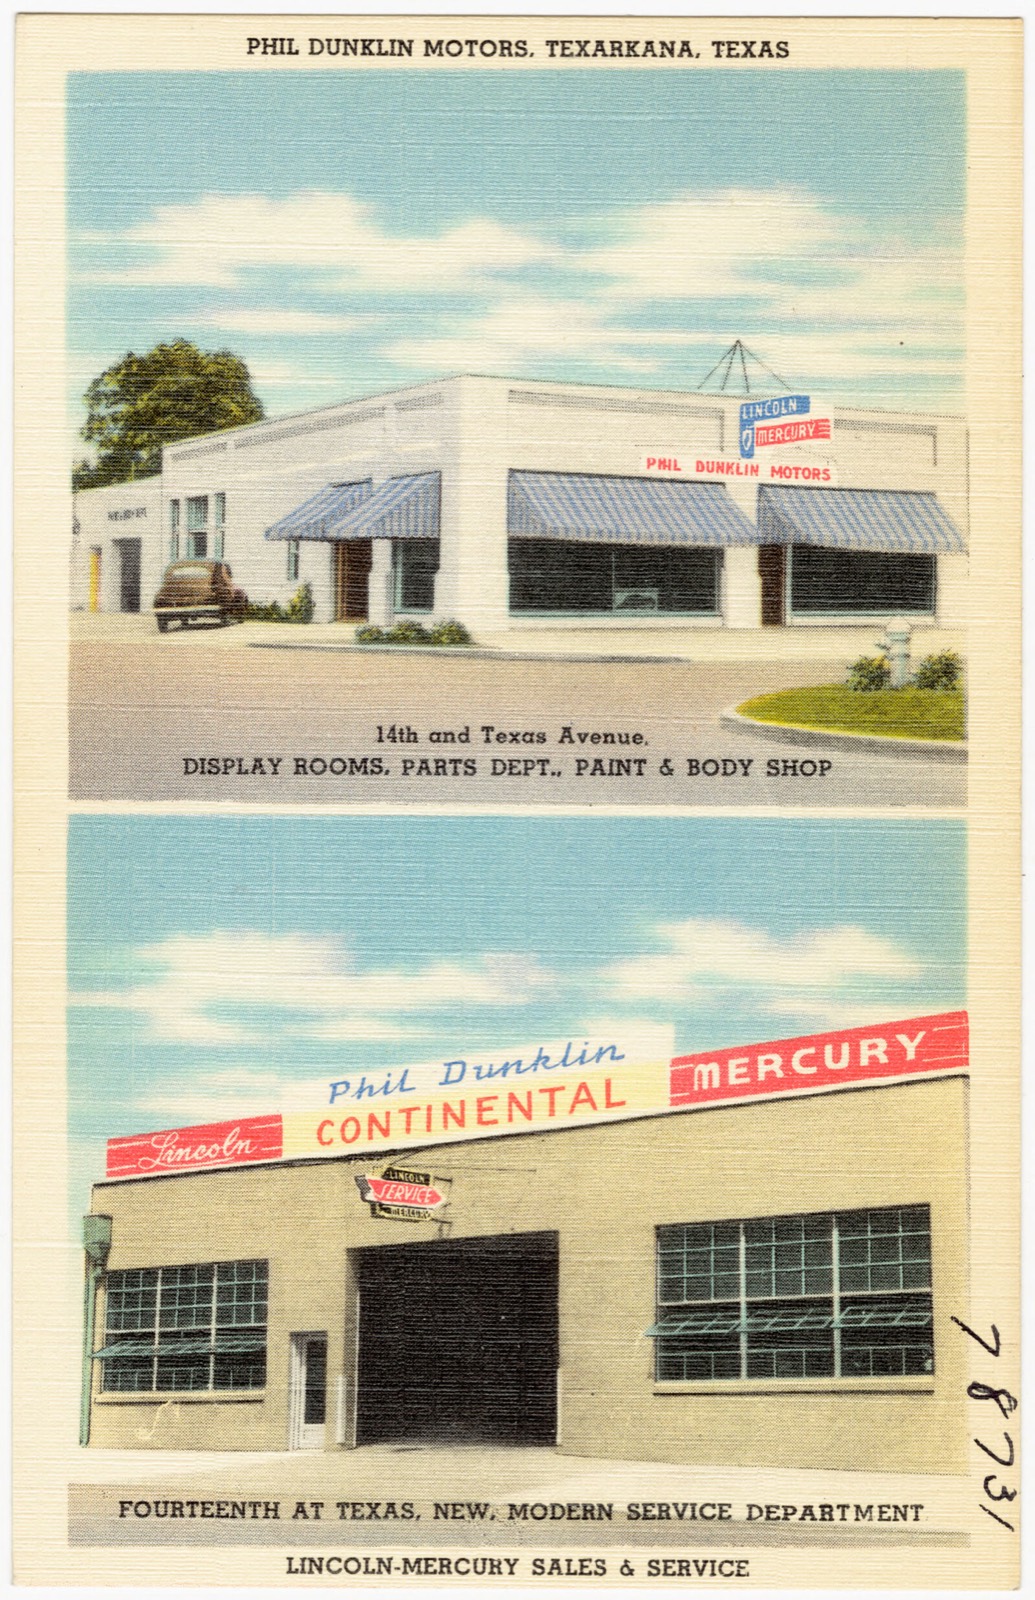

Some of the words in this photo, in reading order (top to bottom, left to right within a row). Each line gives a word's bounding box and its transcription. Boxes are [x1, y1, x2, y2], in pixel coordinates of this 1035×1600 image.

[742, 398, 797, 420] LINCOLN
[757, 423, 816, 445] MERCURY
[646, 457, 681, 472] PHIL
[695, 460, 760, 477] DUNKLIN
[770, 465, 831, 481] MOTORS
[329, 1068, 416, 1104] Phil
[438, 1041, 625, 1086] Dunklin
[693, 1031, 926, 1091] MERCURY
[316, 1078, 626, 1146] CONTINENTAL
[138, 1127, 257, 1170] Lincoln
[376, 1184, 432, 1203] SERVICE
[389, 1170, 426, 1184] LINCOLN
[950, 1315, 1018, 1532] 78731
